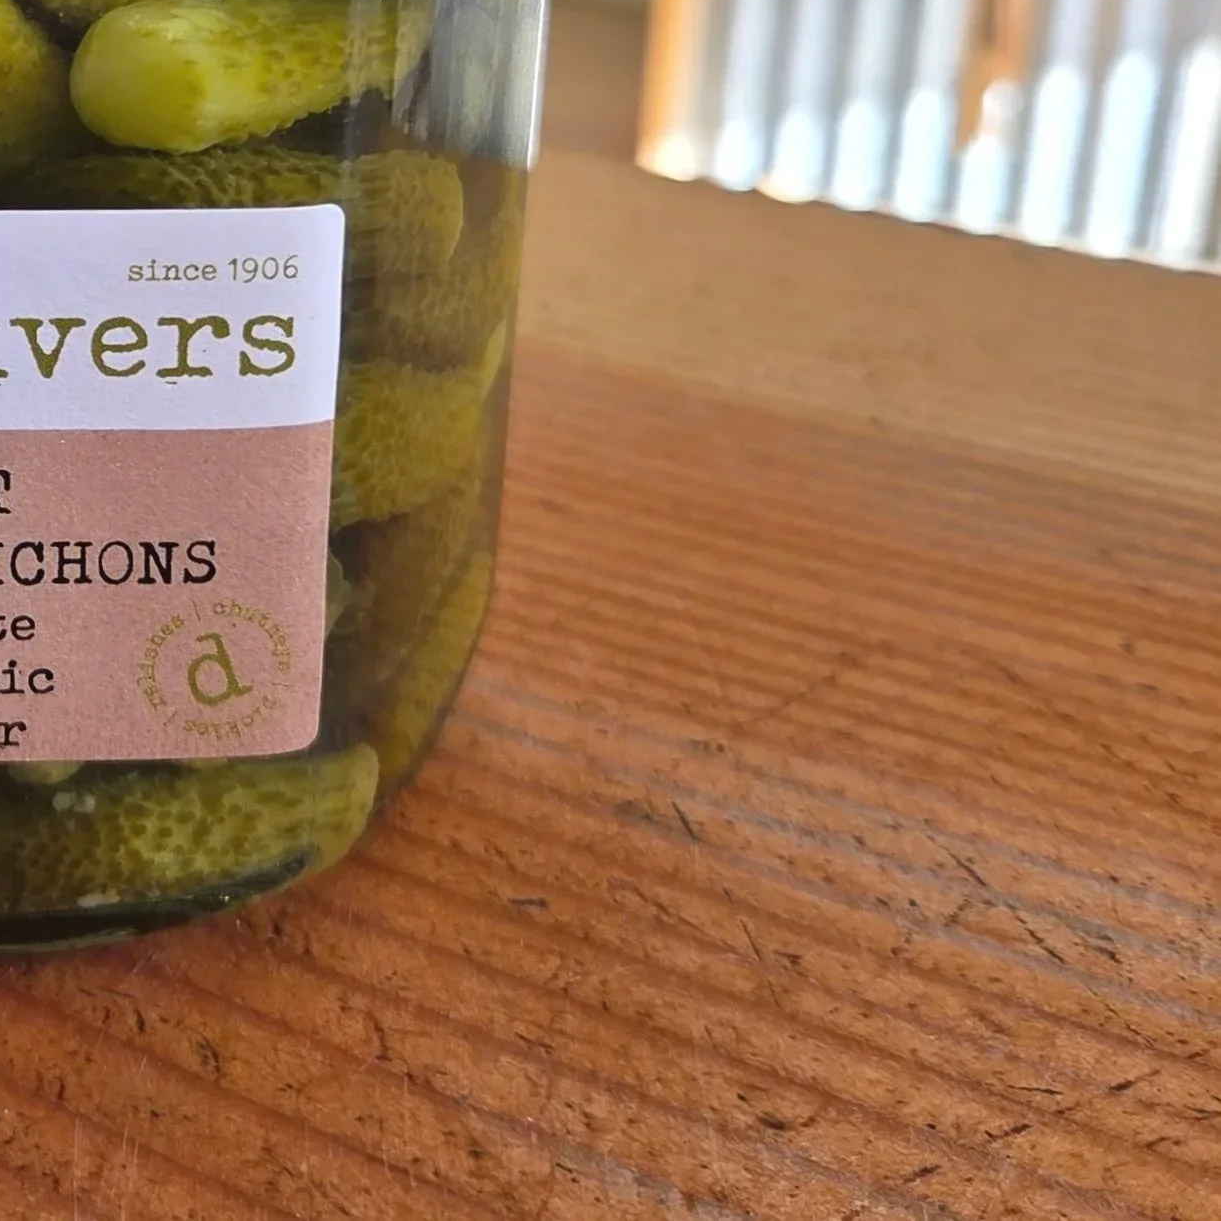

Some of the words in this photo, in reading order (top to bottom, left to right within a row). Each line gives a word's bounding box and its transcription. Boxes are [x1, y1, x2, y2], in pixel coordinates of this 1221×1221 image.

[128, 260, 218, 282] since
[228, 256, 299, 282] 1906
[188, 632, 254, 706] d
